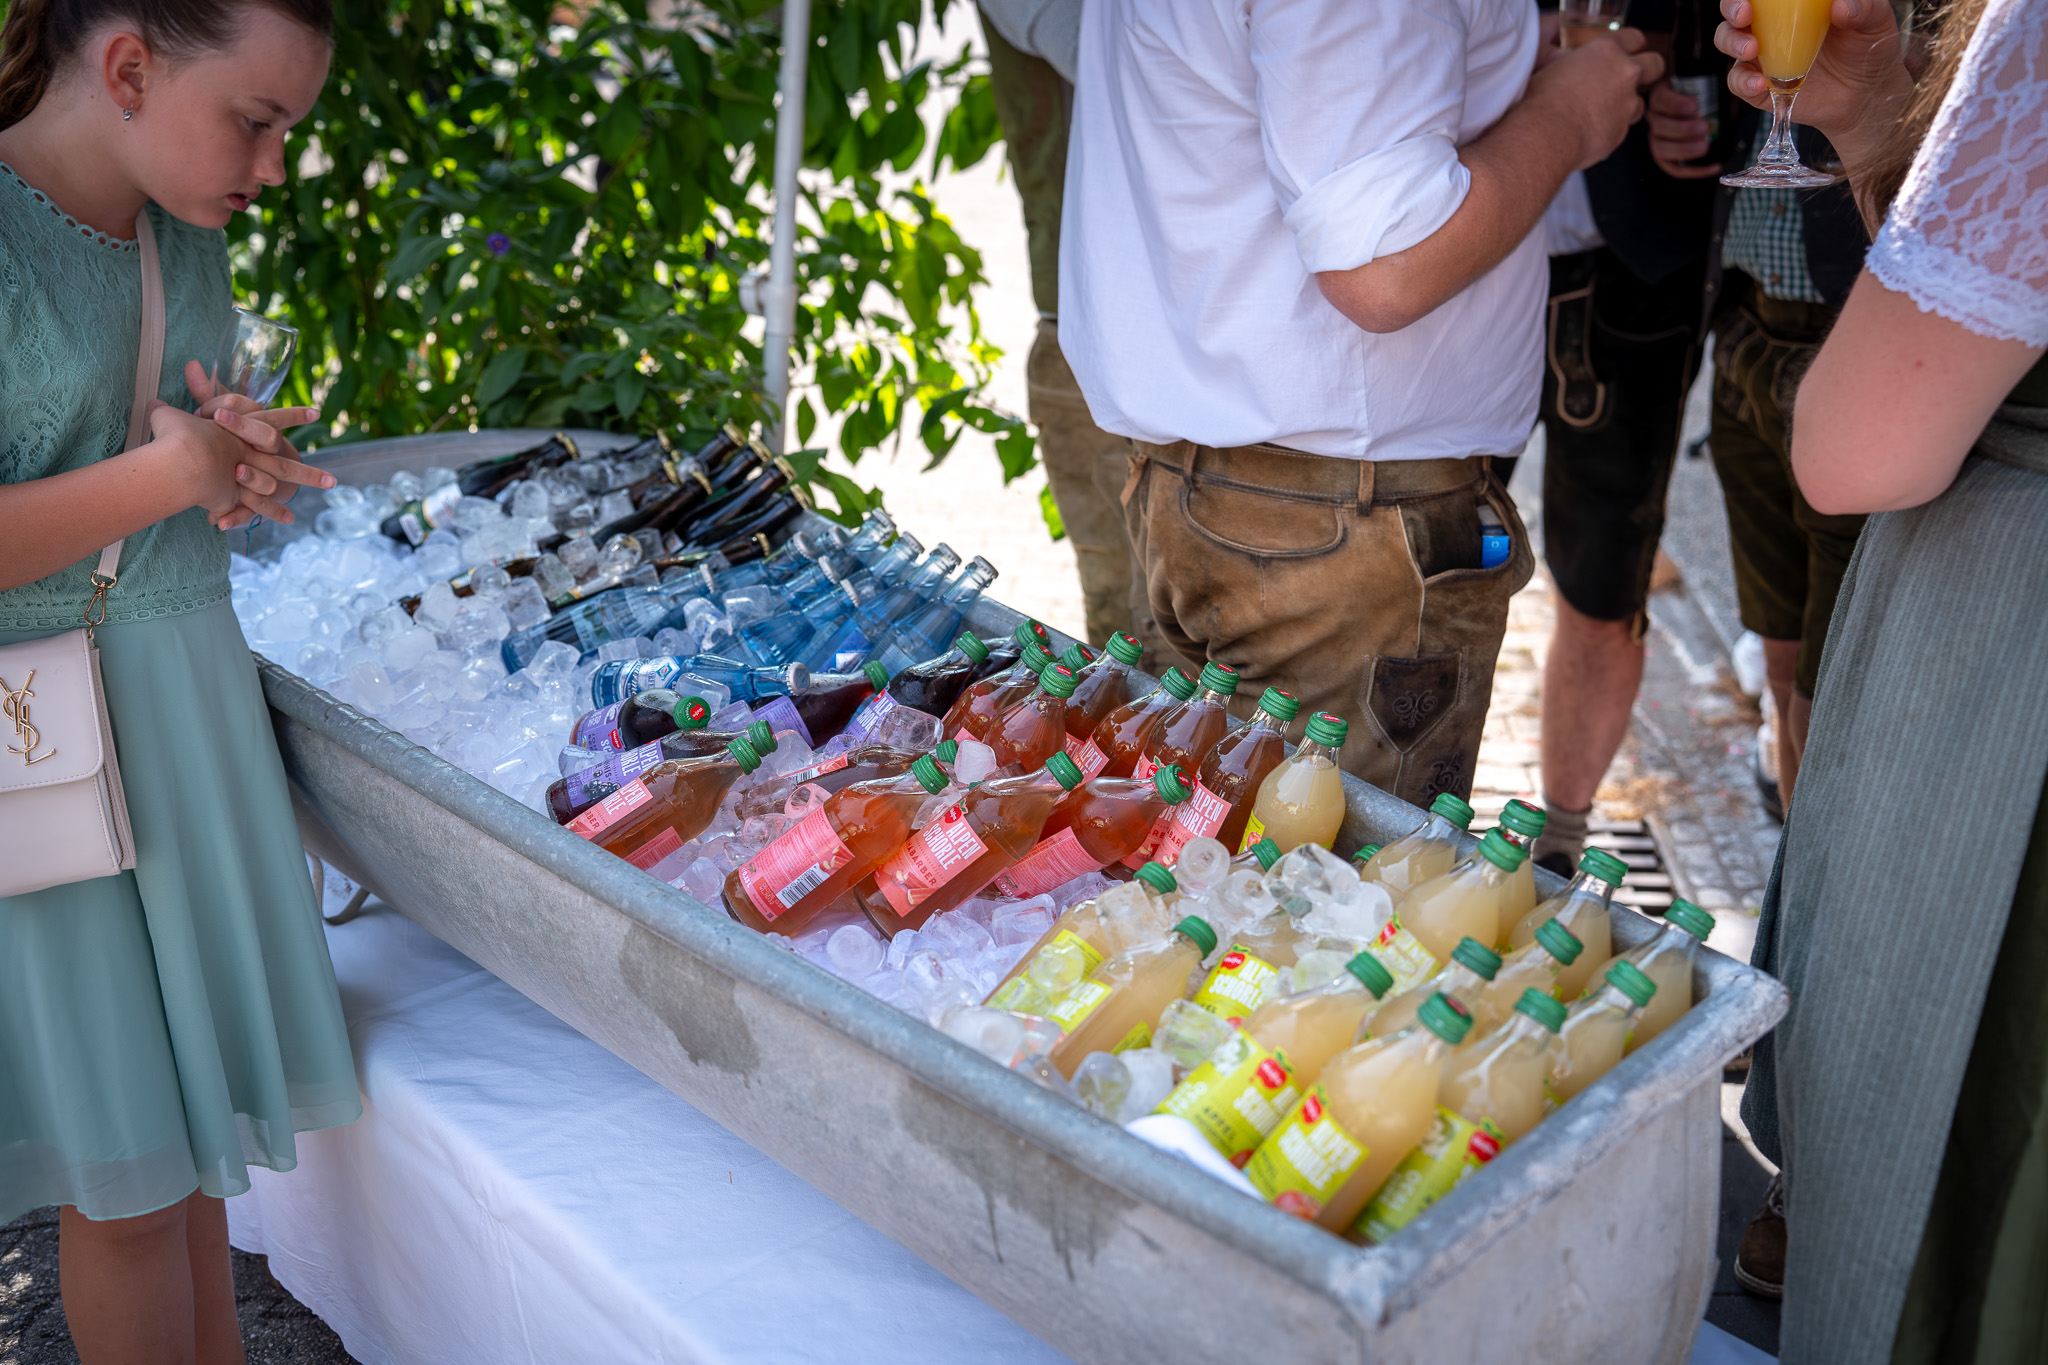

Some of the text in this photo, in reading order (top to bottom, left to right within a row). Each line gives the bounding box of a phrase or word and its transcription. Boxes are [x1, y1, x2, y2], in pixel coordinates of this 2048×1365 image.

[1192, 788, 1224, 823] ALPEN
[922, 822, 962, 871] SCHORLE
[946, 821, 981, 860] ALPEN
[1238, 960, 1276, 986] ALP
